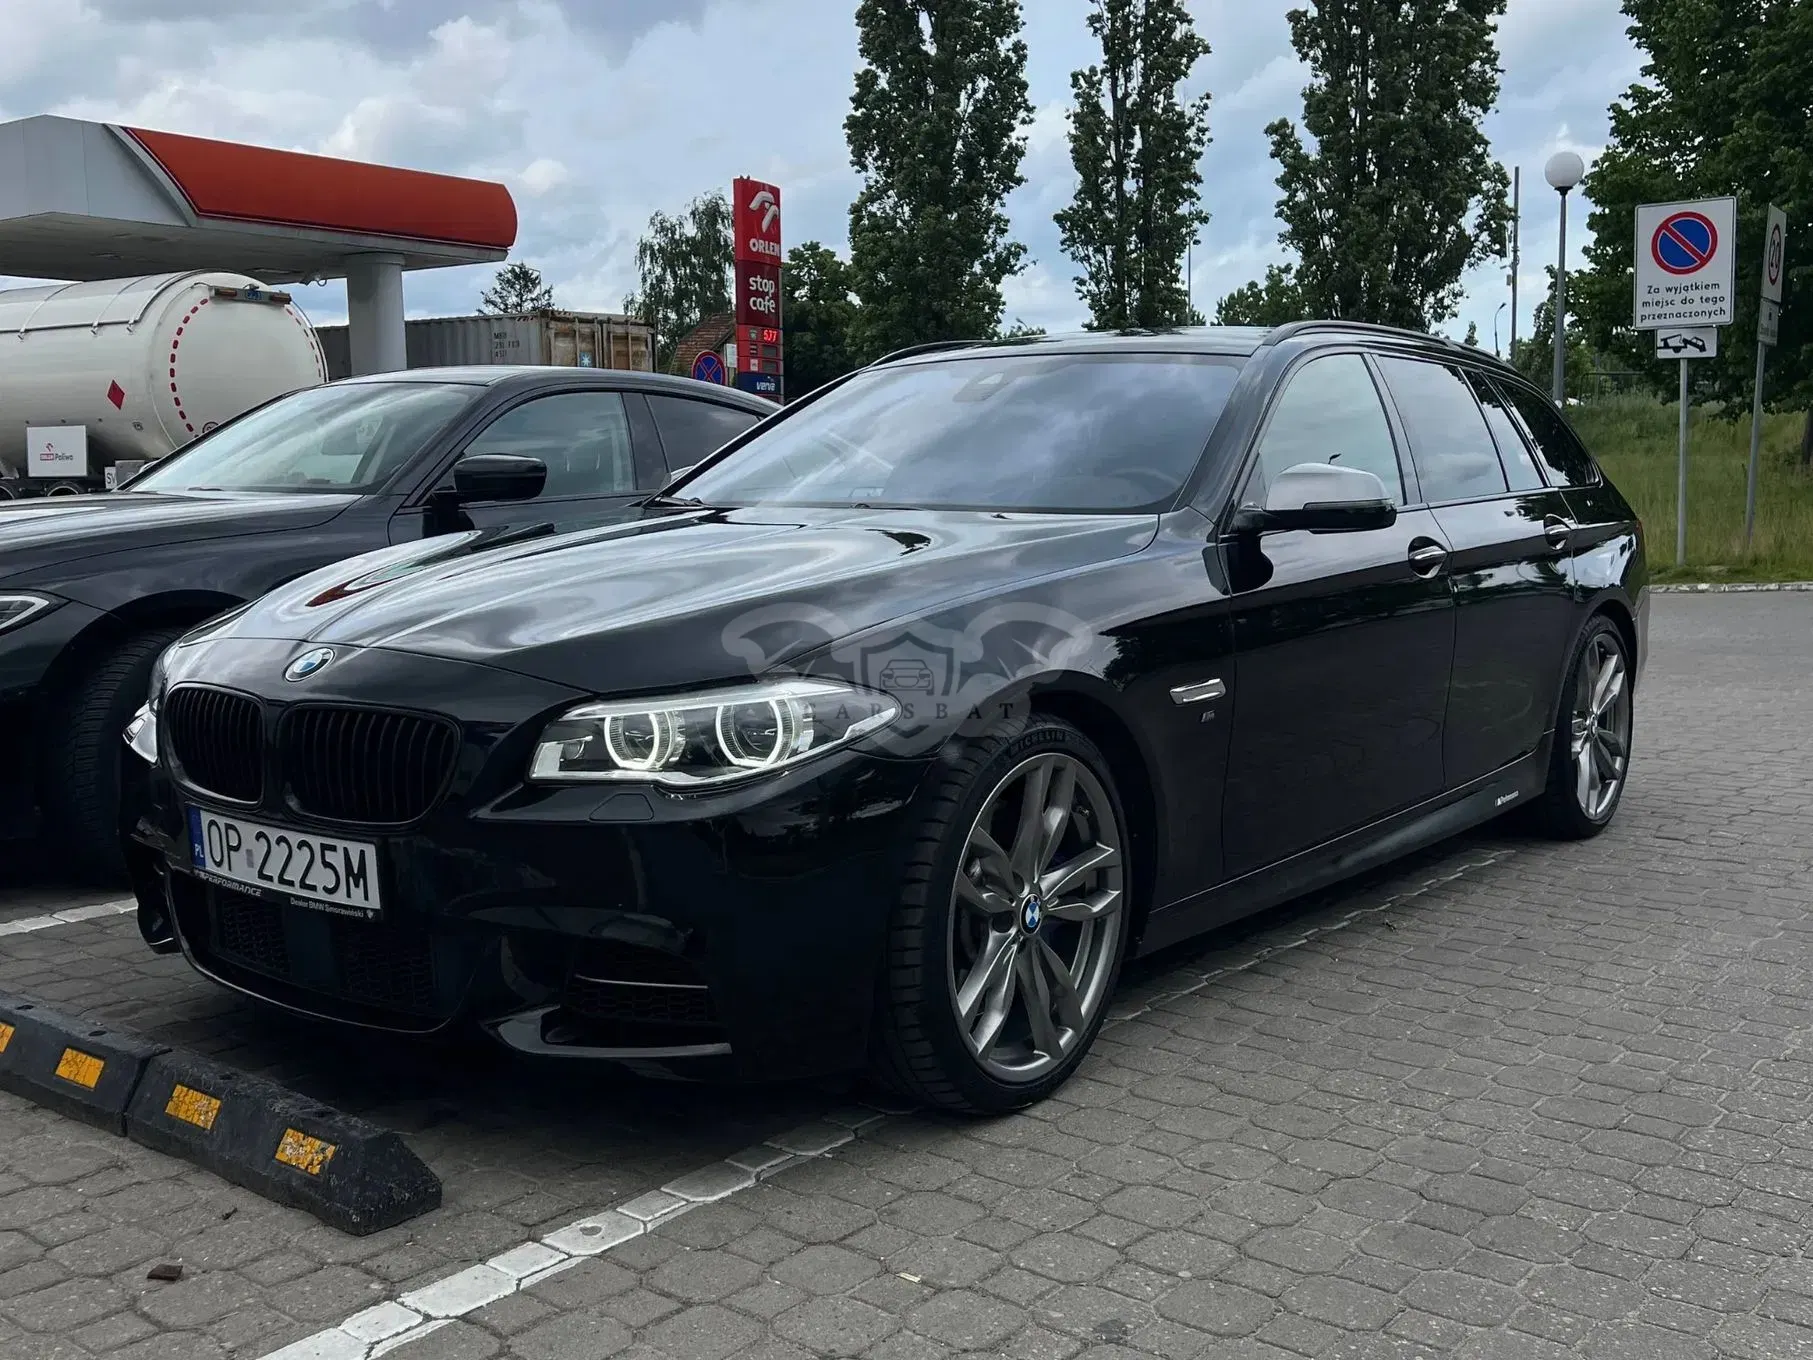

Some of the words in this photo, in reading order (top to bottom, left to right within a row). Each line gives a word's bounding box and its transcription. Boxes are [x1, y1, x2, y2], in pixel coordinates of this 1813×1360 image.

[749, 238, 780, 256] ORLEN
[749, 275, 775, 297] stop
[1647, 285, 1660, 294] Za
[1665, 281, 1720, 295] wyjątkiem
[749, 296, 776, 314] cafe
[1642, 297, 1676, 308] miejsc
[1680, 296, 1695, 305] do
[1700, 295, 1725, 305] tego
[1640, 307, 1726, 323] przeznaczonych
[194, 843, 204, 858] PL
[207, 819, 242, 872] OP
[255, 830, 370, 902] 2225M
